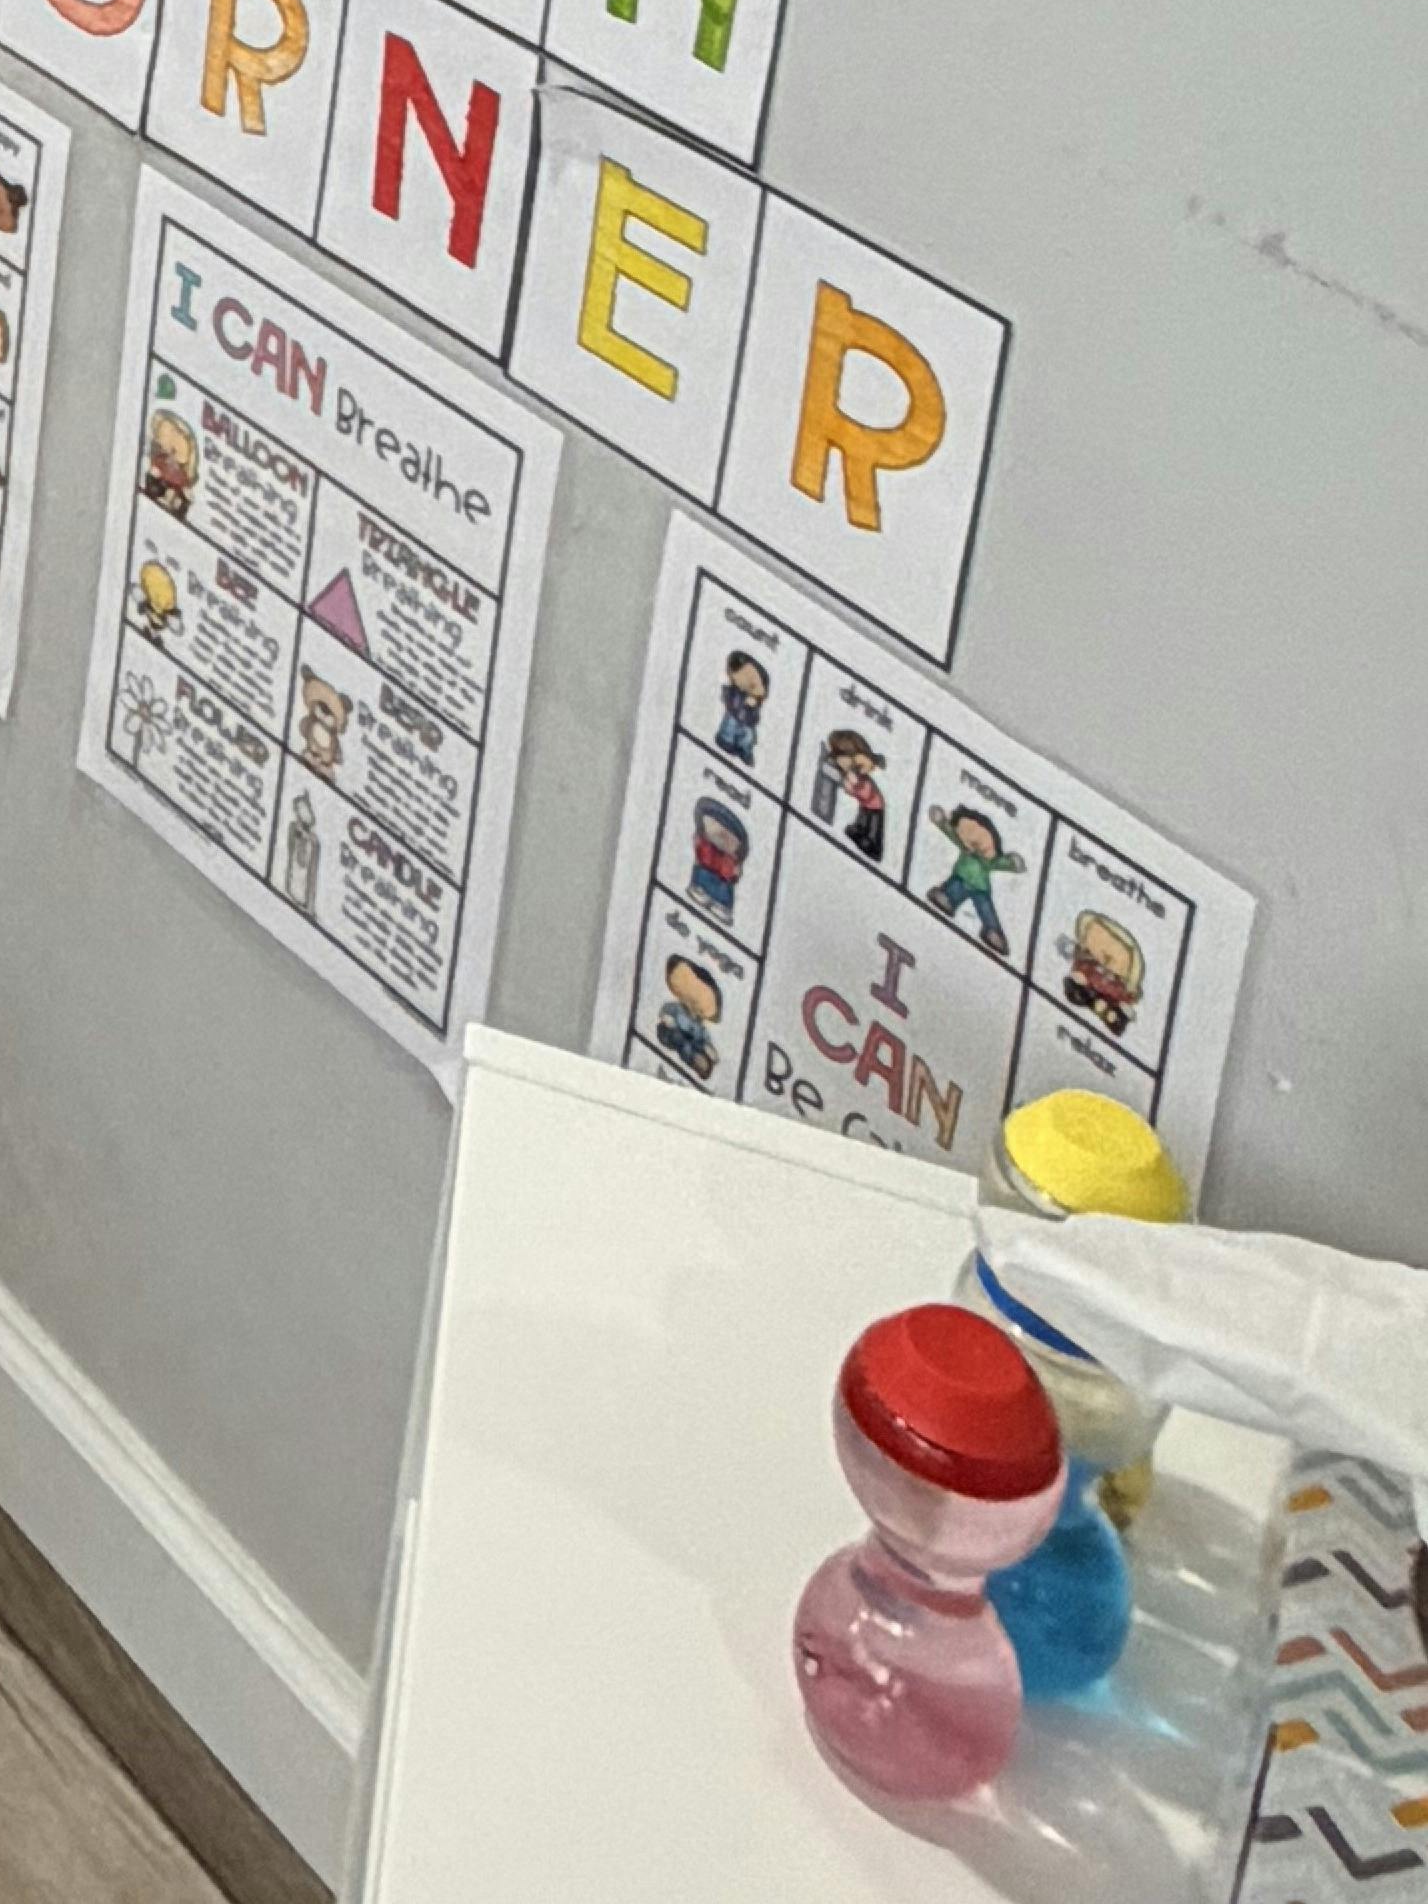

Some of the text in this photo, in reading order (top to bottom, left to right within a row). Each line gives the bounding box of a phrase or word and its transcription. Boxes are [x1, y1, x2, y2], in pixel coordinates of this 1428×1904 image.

[170, 260, 203, 333] I
[211, 295, 329, 418] CAN
[334, 386, 492, 527] Breathe
[200, 398, 309, 498] BALLOON
[357, 510, 481, 625] TRIANGLE
[173, 674, 271, 769] FLOWER
[346, 818, 443, 913] CANDLE
[1066, 835, 1168, 922] breathe
[868, 931, 916, 1021] I
[800, 983, 963, 1152] CAN
